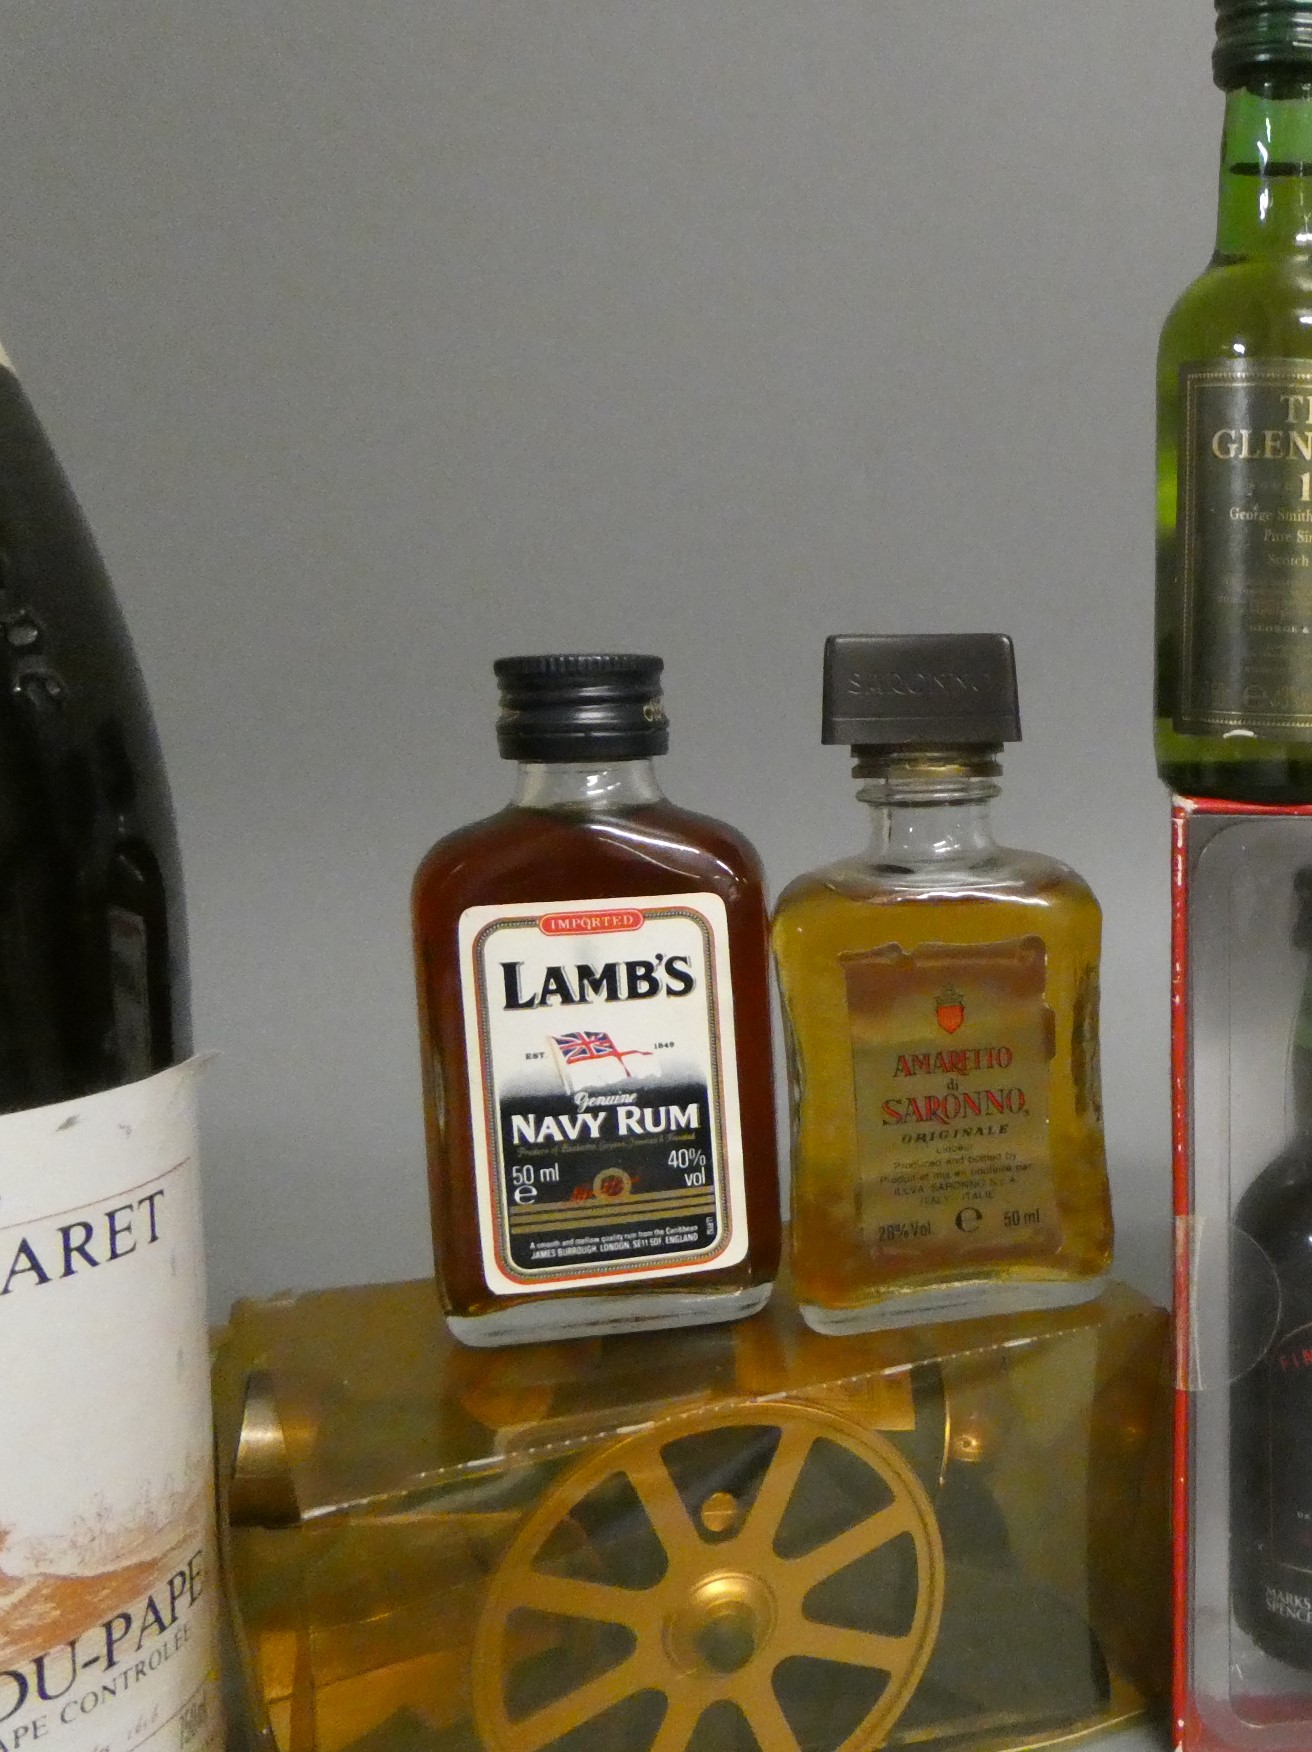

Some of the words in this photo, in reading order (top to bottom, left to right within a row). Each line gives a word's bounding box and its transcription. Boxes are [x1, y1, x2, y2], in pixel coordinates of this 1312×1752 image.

[1267, 554, 1309, 567] Scotch
[551, 915, 633, 930] IMPORTED
[499, 953, 697, 1011] LAMB'S
[653, 1042, 675, 1050] 1849
[893, 1046, 1013, 1078] AMARETTO
[947, 1077, 959, 1092] di
[574, 1092, 638, 1112] Genuine
[882, 1087, 1026, 1126] SARONNO
[511, 1112, 607, 1145] NAVY
[617, 1103, 701, 1135] RUM
[902, 1124, 1008, 1144] ORIGINALE
[668, 1148, 706, 1168] 40%
[512, 1165, 534, 1185] 50
[540, 1163, 560, 1182] ml
[685, 1171, 706, 1187] vol
[1004, 1209, 1021, 1228] 50
[1024, 1208, 1040, 1225] ml
[530, 1248, 556, 1260] JAMES
[665, 1232, 699, 1244] ENGLAND
